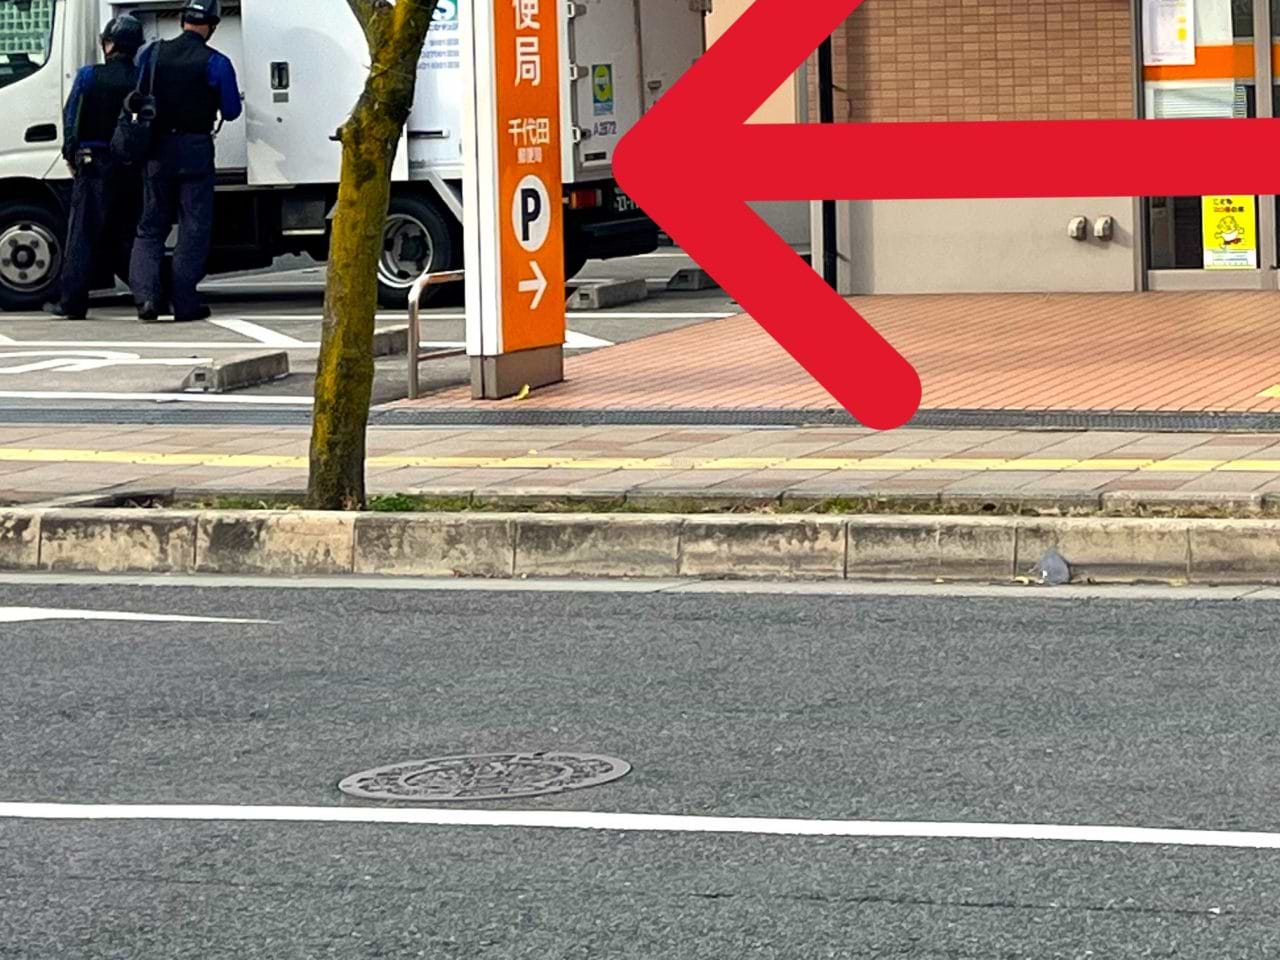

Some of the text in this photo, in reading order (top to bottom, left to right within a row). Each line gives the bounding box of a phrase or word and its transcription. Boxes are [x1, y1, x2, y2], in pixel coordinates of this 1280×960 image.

[508, 118, 549, 145] 千代田
[520, 188, 541, 241] P
